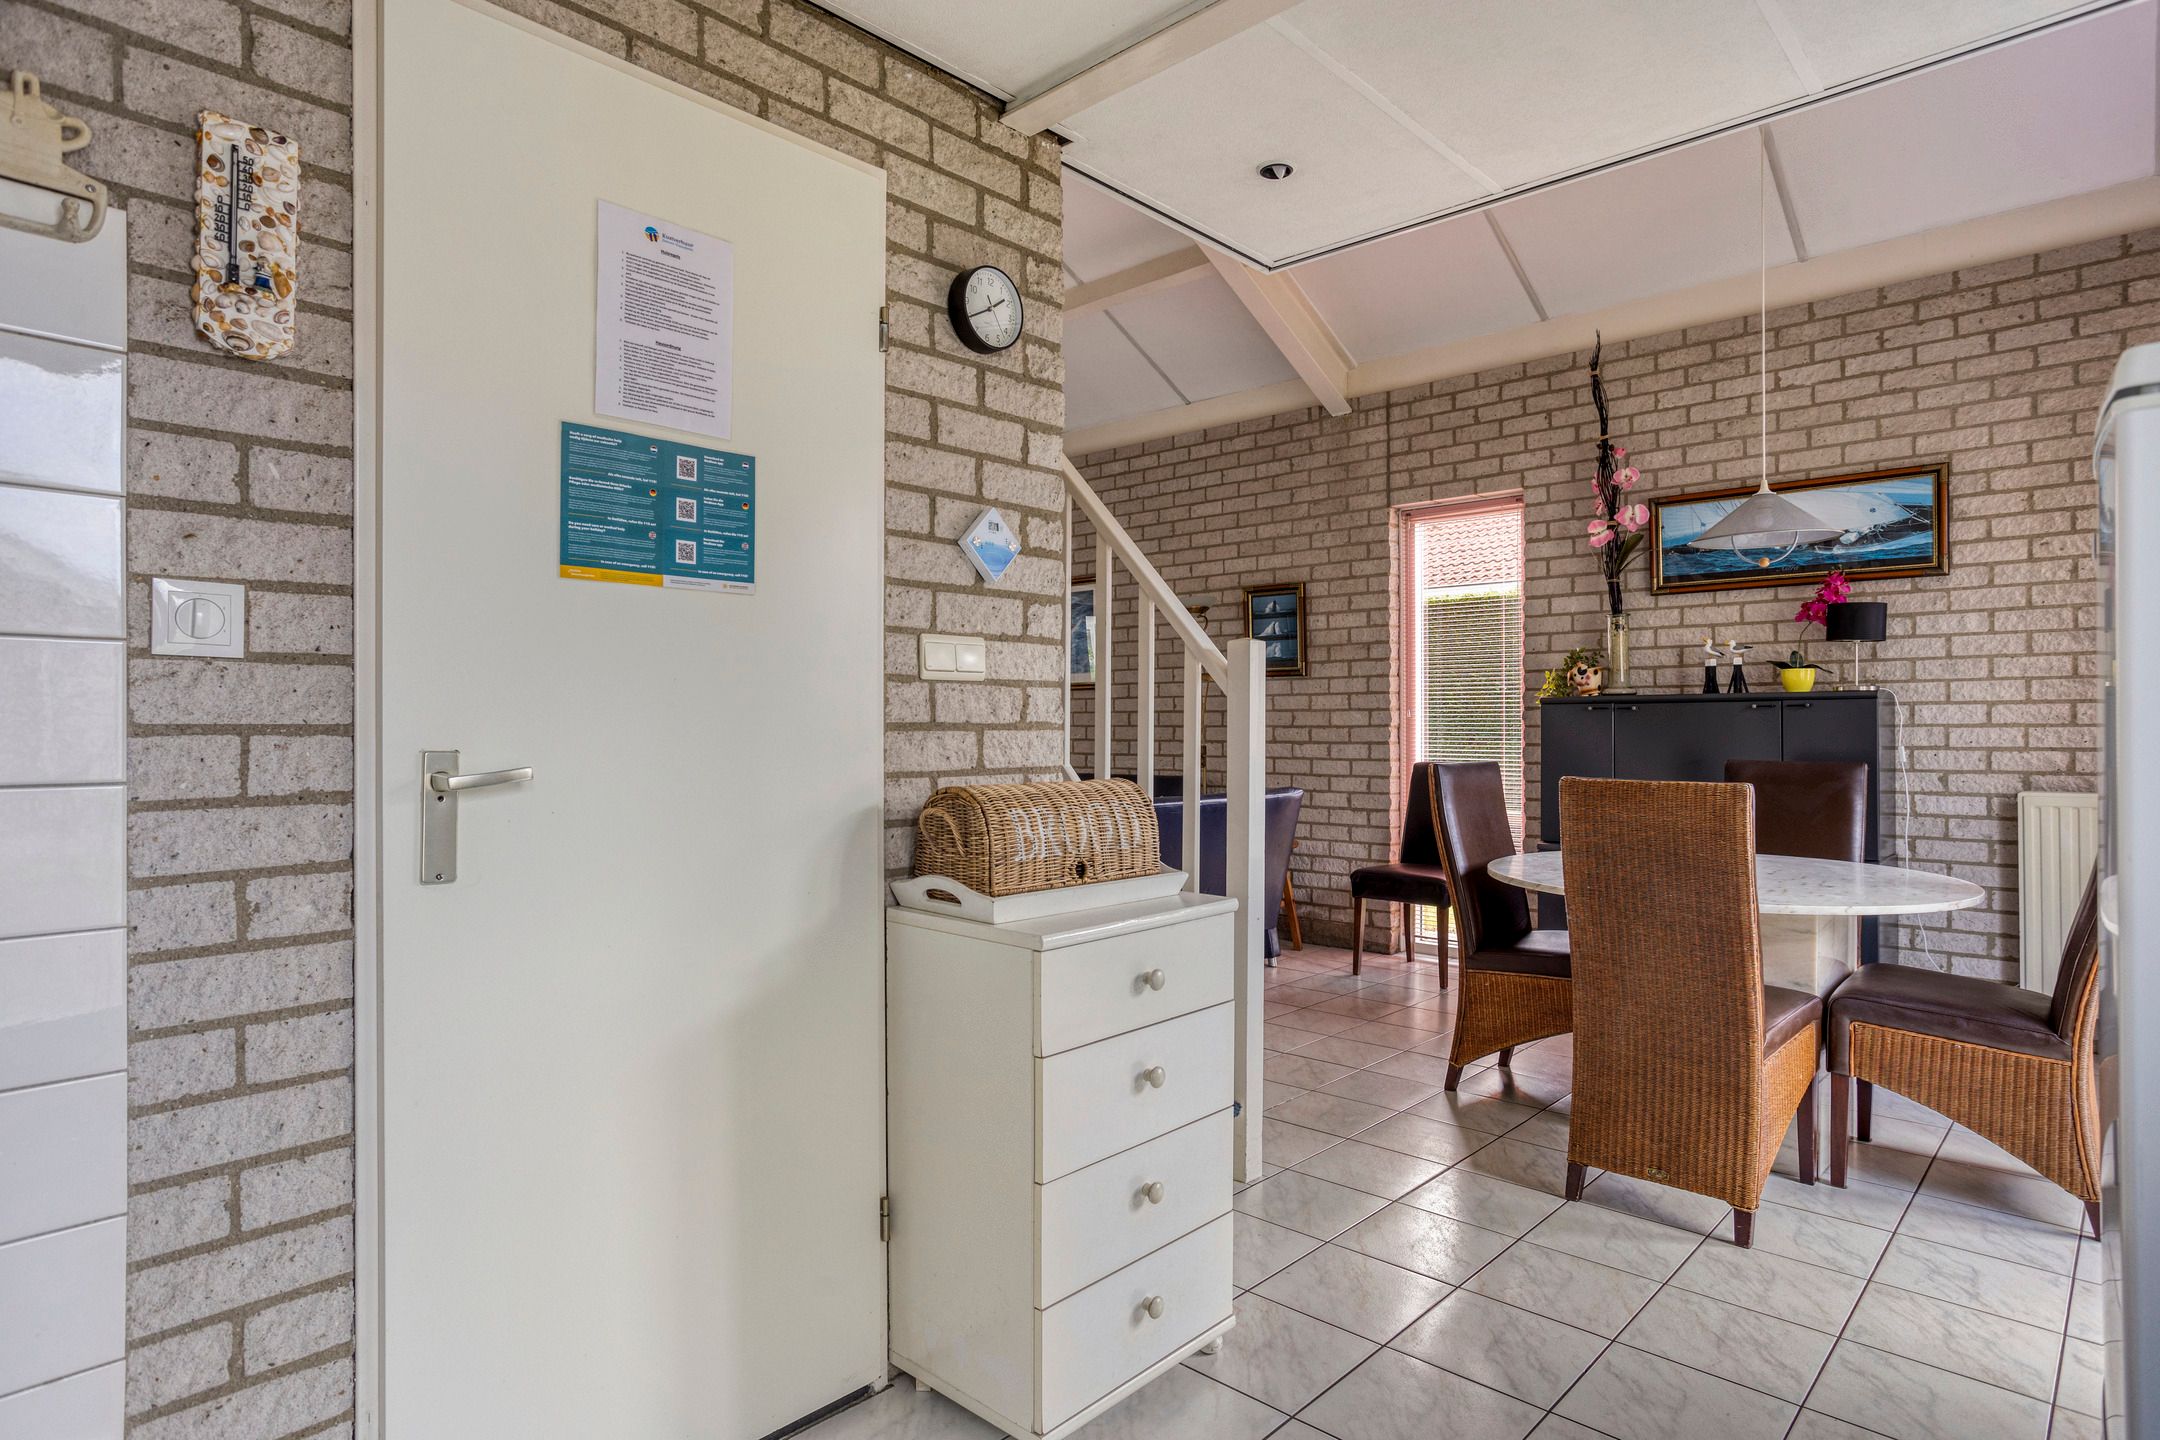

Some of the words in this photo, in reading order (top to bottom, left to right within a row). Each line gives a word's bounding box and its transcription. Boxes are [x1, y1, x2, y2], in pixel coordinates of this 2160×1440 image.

[243, 156, 254, 166] 50
[243, 184, 253, 194] 20
[215, 214, 225, 223] 20
[978, 277, 983, 287] 11
[988, 278, 995, 287] 12
[970, 285, 978, 294] 10
[985, 334, 990, 342] 6
[1010, 801, 1142, 862] BROOD
